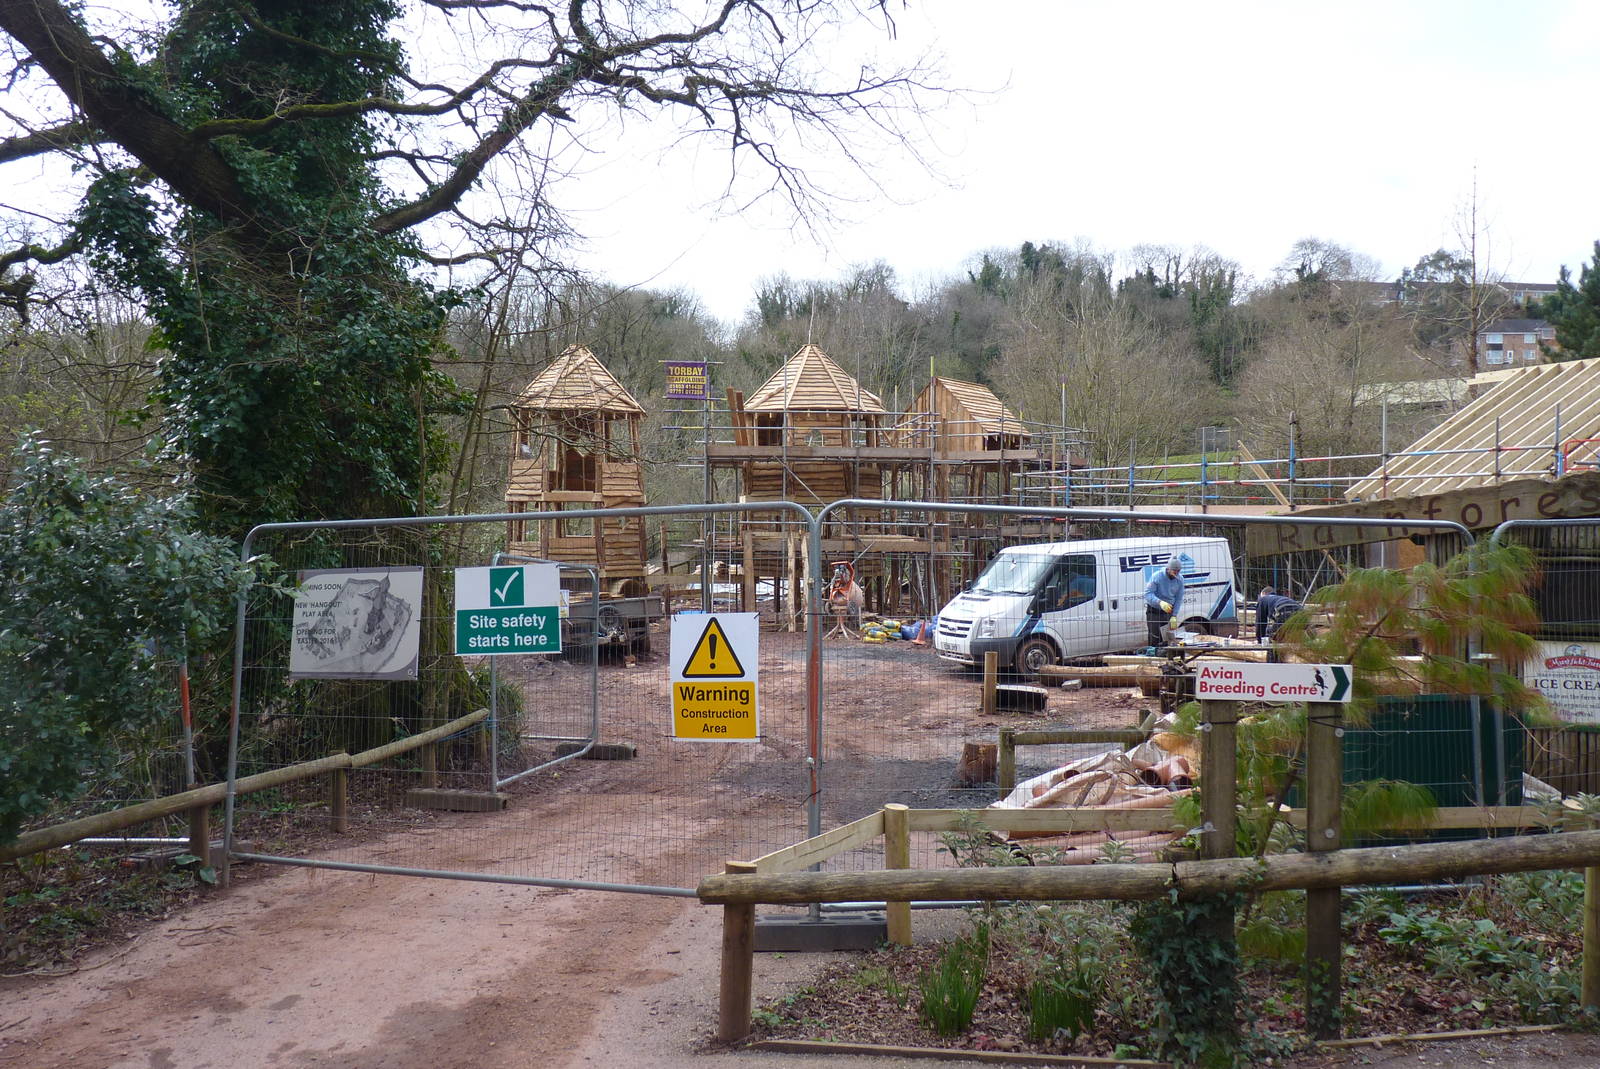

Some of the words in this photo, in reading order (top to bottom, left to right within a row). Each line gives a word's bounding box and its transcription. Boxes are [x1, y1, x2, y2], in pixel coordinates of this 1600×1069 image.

[669, 366, 703, 376] TORBAY
[1119, 553, 1172, 573] LEE
[469, 615, 498, 629] Site
[501, 613, 547, 630] safety
[468, 634, 510, 648] starts
[514, 632, 548, 646] here
[1200, 667, 1243, 679] Avian
[1199, 681, 1265, 697] Breeding
[1270, 682, 1318, 695] Centre
[1533, 678, 1559, 689] ICE
[679, 686, 750, 705] Warning
[681, 708, 749, 719] Construction
[702, 723, 727, 733] Area
